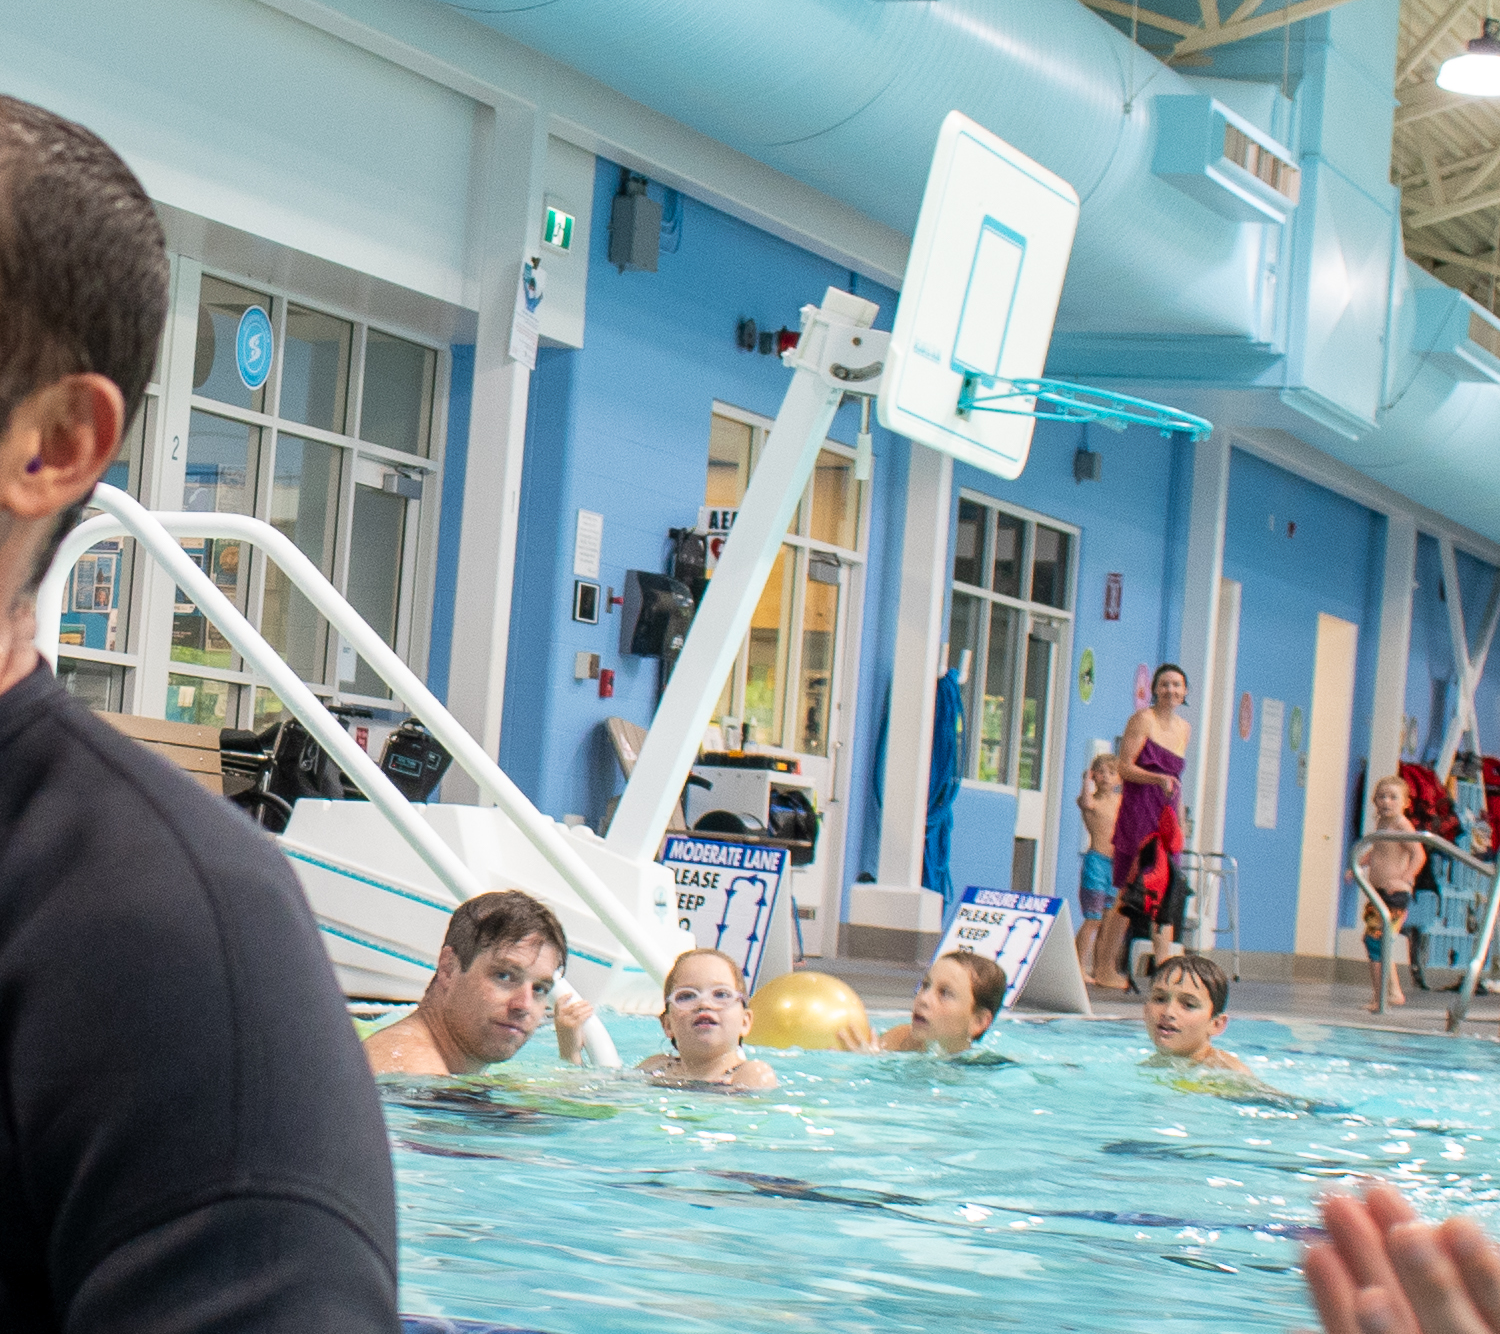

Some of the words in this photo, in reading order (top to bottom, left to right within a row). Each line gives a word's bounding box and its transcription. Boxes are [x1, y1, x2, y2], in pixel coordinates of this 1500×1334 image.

[171, 435, 180, 461] 2
[669, 840, 744, 867] MODERATE
[743, 848, 782, 871] LANE
[675, 868, 720, 889] LEASE
[676, 892, 706, 911] EEP
[1016, 893, 1053, 913] LANE
[958, 907, 1006, 926] PLEASE
[957, 926, 990, 941] KEEP
